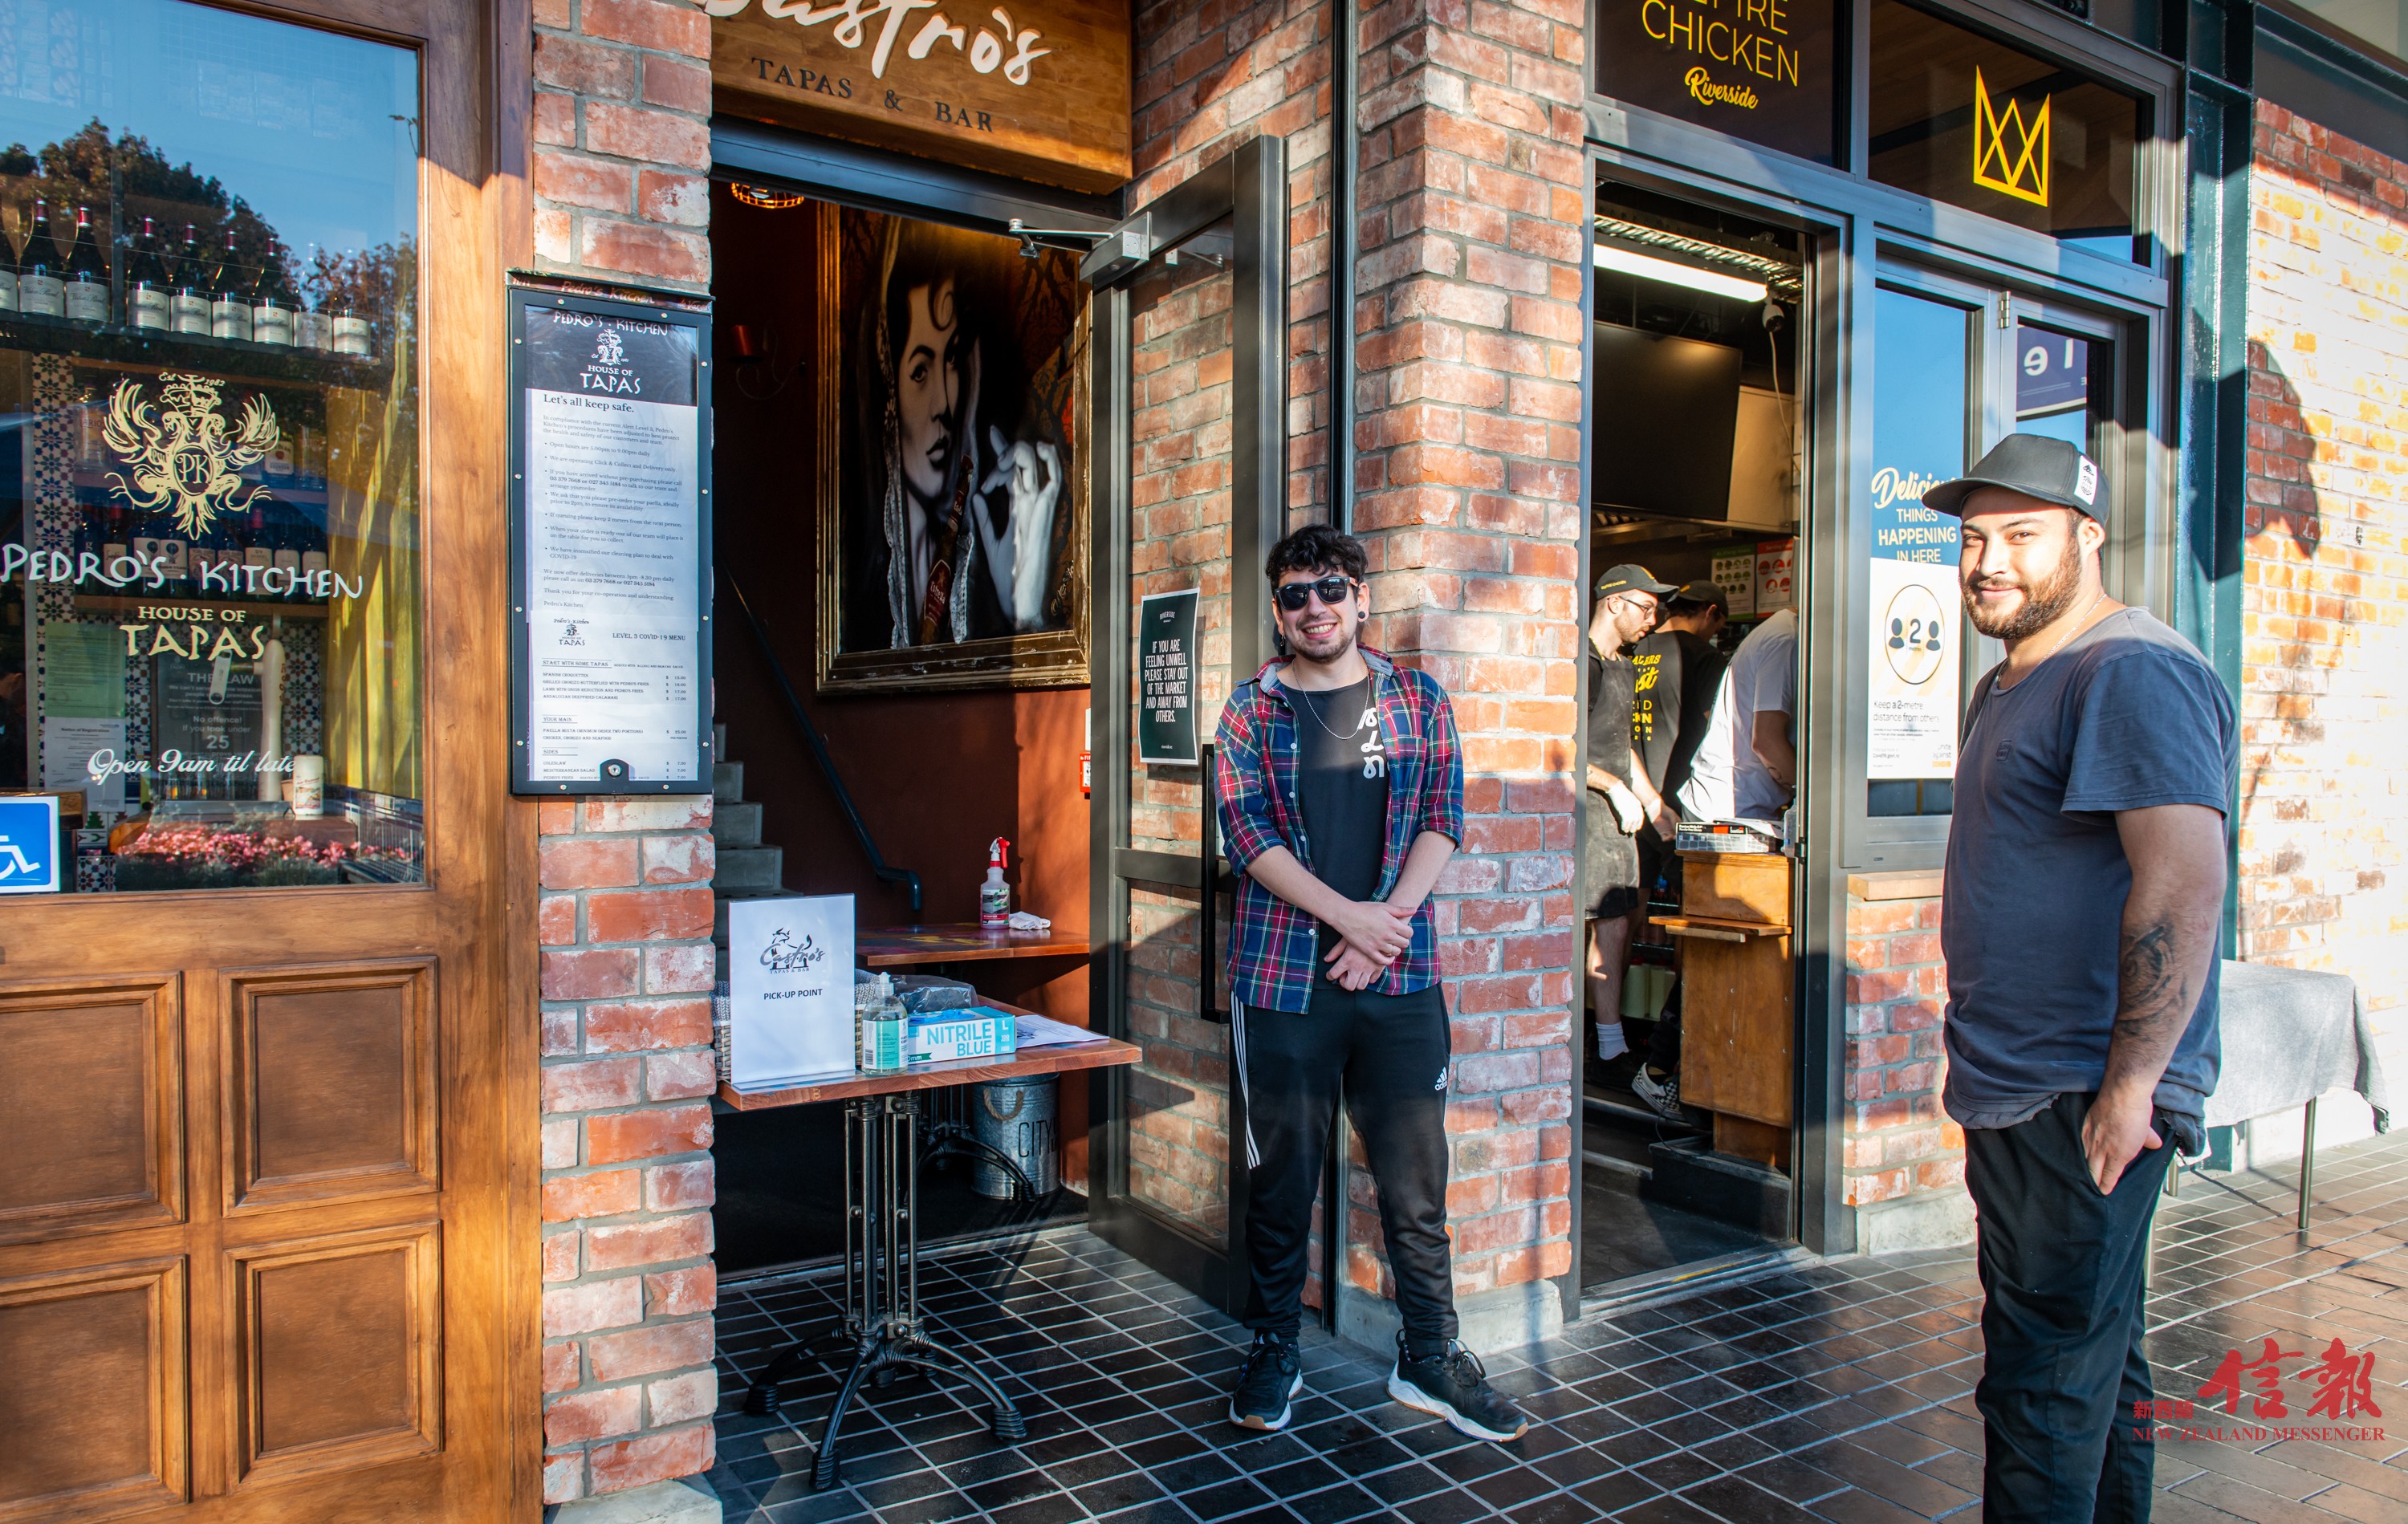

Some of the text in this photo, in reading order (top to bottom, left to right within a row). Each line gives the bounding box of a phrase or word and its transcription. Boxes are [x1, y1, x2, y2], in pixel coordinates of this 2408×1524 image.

[1641, 0, 1798, 87] CHICKEN
[751, 56, 995, 133] TAPAS & BAR
[1684, 67, 1759, 109] Riverside
[553, 311, 668, 336] PEDRO'S KITCHEN
[588, 364, 633, 376] HOUSE OF
[159, 372, 226, 387] Est 1982
[580, 372, 641, 395] TAPAS
[543, 393, 634, 413] Let's all keep safe.
[175, 452, 212, 485] PK
[1896, 508, 1938, 522] THINGS
[1878, 526, 1957, 546] HAPPENING
[1897, 548, 1942, 563] IN HERE
[1, 543, 364, 599] PEDRO'S KITCHEN
[138, 605, 246, 624] HOUSE OF
[1159, 611, 1176, 620] RIVERSIDE
[1910, 618, 1921, 644] 2
[120, 624, 266, 661] TAPAS
[1152, 639, 1180, 653] IF YOU ARE
[1145, 652, 1186, 668] FEELING UNWELL
[1145, 667, 1188, 681] PLEASE STAY OUT
[1147, 681, 1186, 695] OF THE MARKET
[1145, 695, 1187, 709] AND AWAY FROM
[1874, 701, 1891, 710] Keep
[1898, 701, 1923, 709] 2-metre
[207, 715, 242, 724] offence!
[1155, 709, 1176, 723] OTHERS.
[1873, 713, 1939, 722] distance from others
[206, 725, 226, 733] look
[206, 735, 230, 749] 25
[87, 748, 151, 786] Open
[161, 749, 215, 774] 9am
[226, 750, 255, 774] til
[255, 750, 296, 774] late
[760, 943, 826, 968] Castro's
[763, 988, 823, 1001] PICK-UP POINT
[1002, 1020, 1008, 1030] L
[927, 1022, 992, 1046] NITRILE
[957, 1040, 992, 1057] BLUE
